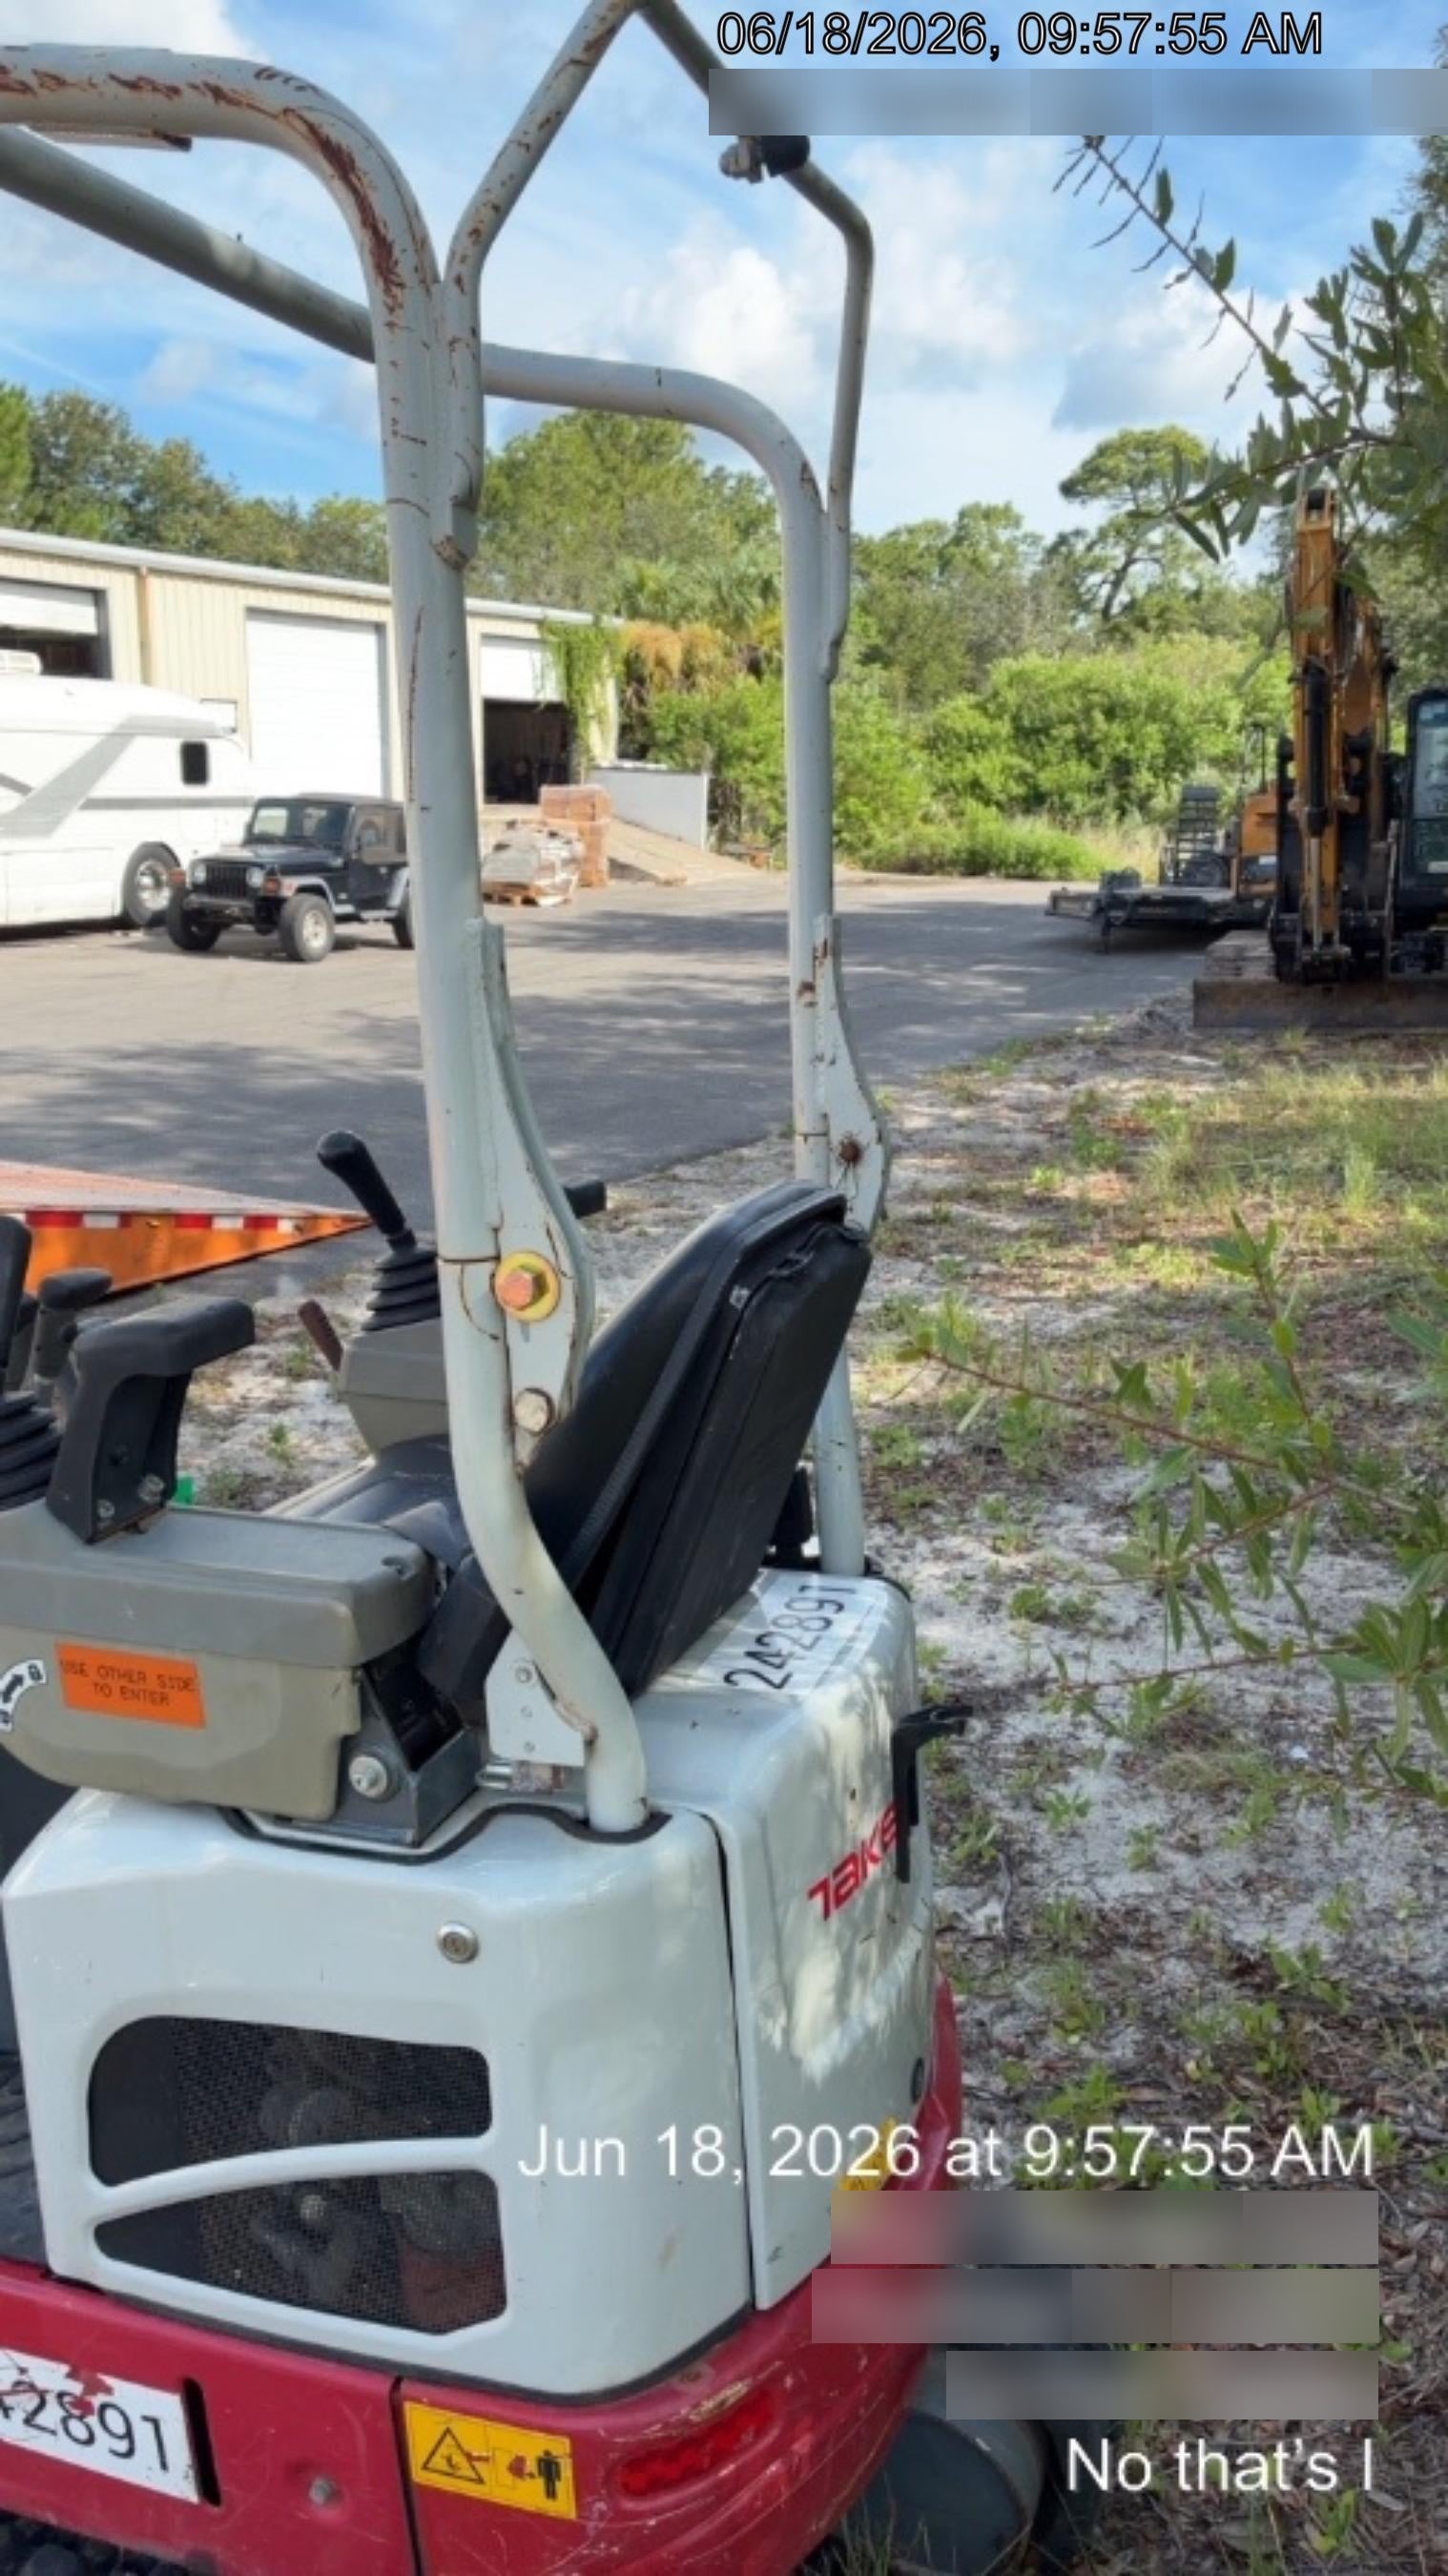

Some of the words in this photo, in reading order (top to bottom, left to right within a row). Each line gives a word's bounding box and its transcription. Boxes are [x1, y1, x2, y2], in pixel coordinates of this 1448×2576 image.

[723, 1585, 858, 1691] 242891
[96, 1665, 147, 1685] OTHER
[156, 1673, 197, 1693] SIDE
[93, 1682, 113, 1698] TO
[119, 1685, 171, 1707] ENTER
